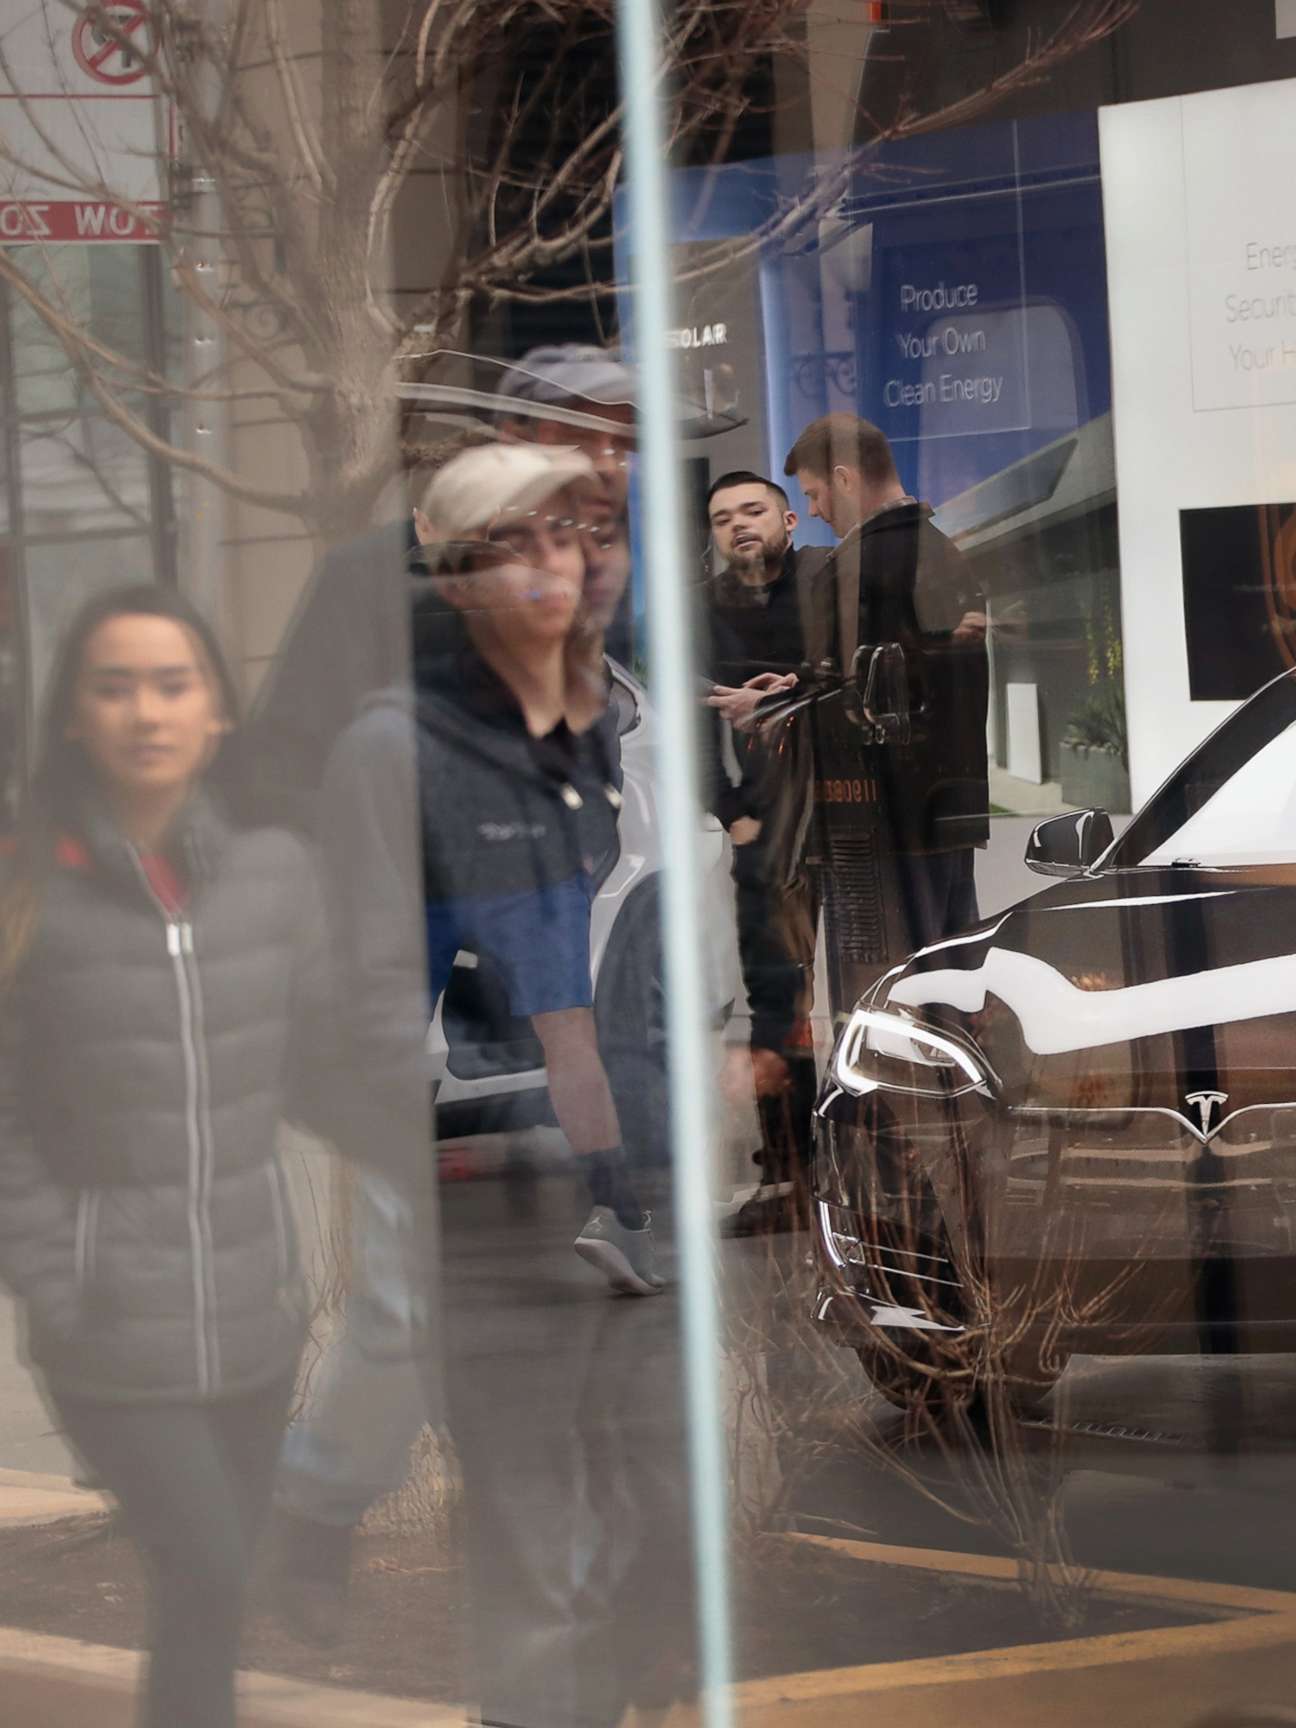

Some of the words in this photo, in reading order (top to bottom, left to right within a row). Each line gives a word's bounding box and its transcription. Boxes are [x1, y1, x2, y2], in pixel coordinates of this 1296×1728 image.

[899, 281, 979, 313] Produce
[897, 332, 939, 360] Your
[942, 327, 987, 355] Own
[1228, 342, 1276, 372] Your
[883, 377, 937, 408] Clean
[938, 373, 1004, 405] Energy
